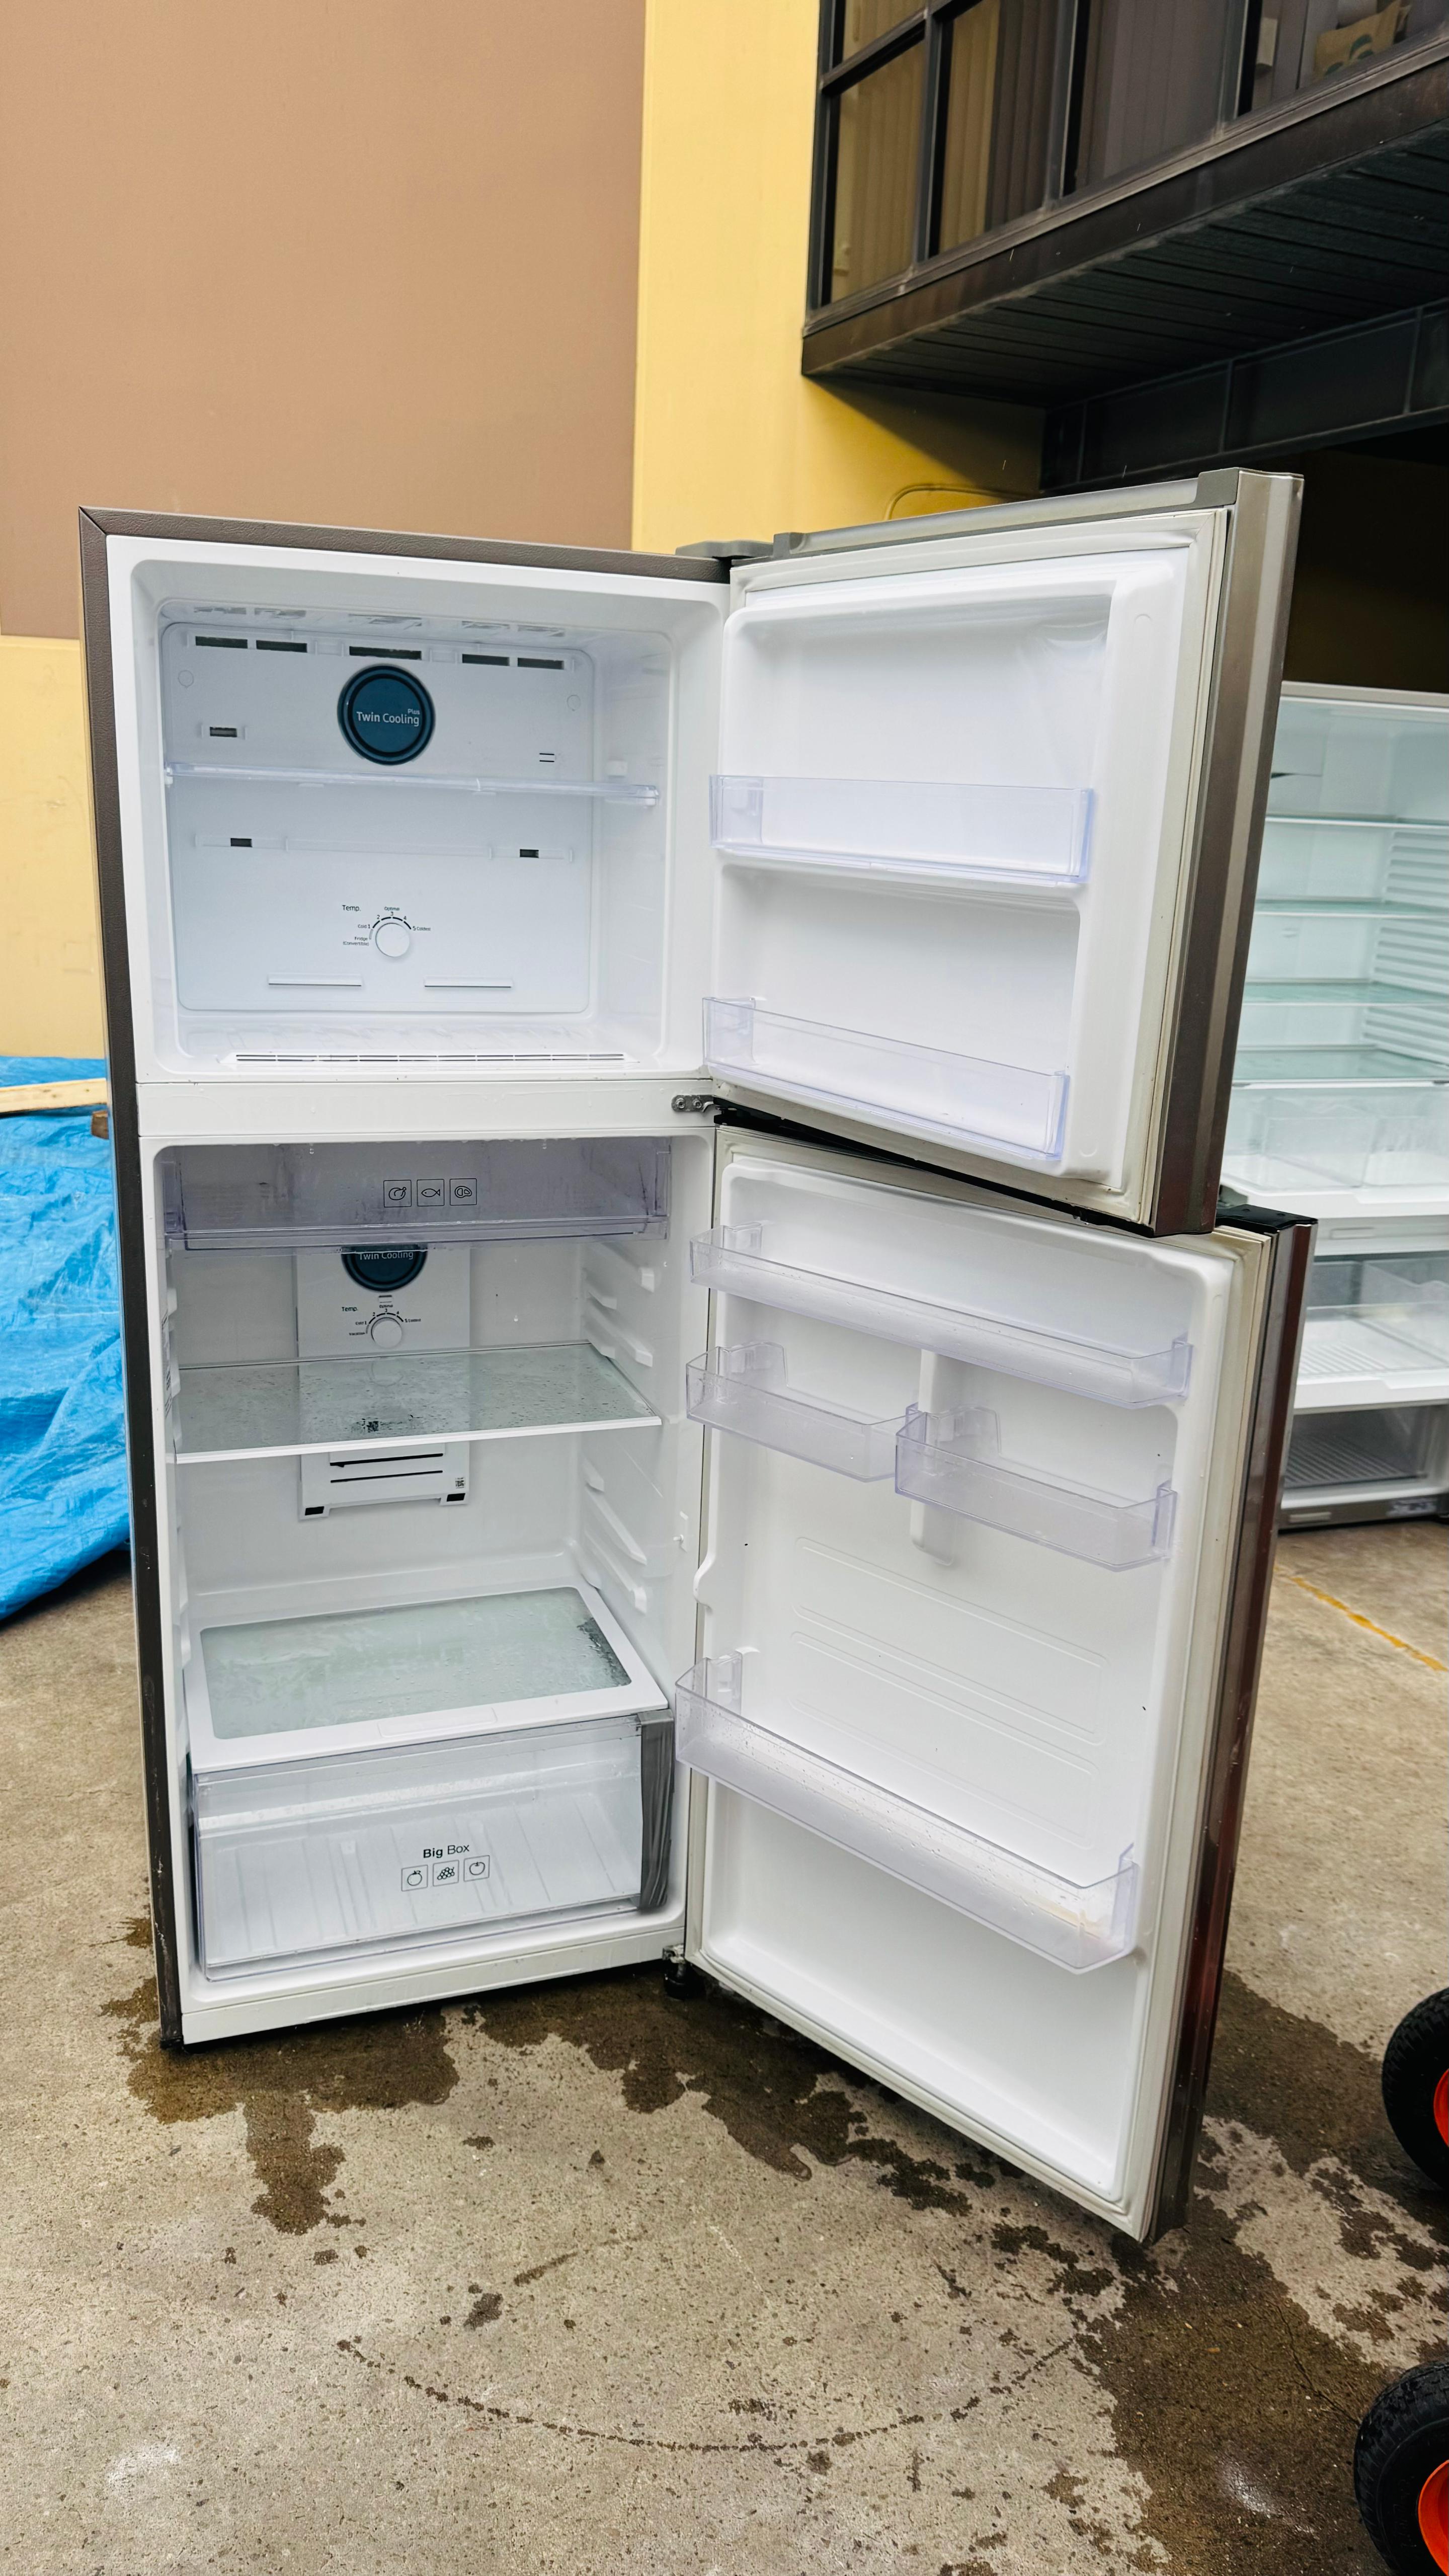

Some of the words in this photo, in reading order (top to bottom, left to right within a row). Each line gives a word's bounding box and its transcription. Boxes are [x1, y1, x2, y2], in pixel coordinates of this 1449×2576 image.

[356, 711, 380, 722] Twin
[382, 713, 420, 727] Cooling
[382, 1252, 414, 1260] Cooling
[423, 1847, 443, 1858] Big
[448, 1844, 469, 1855] Box
